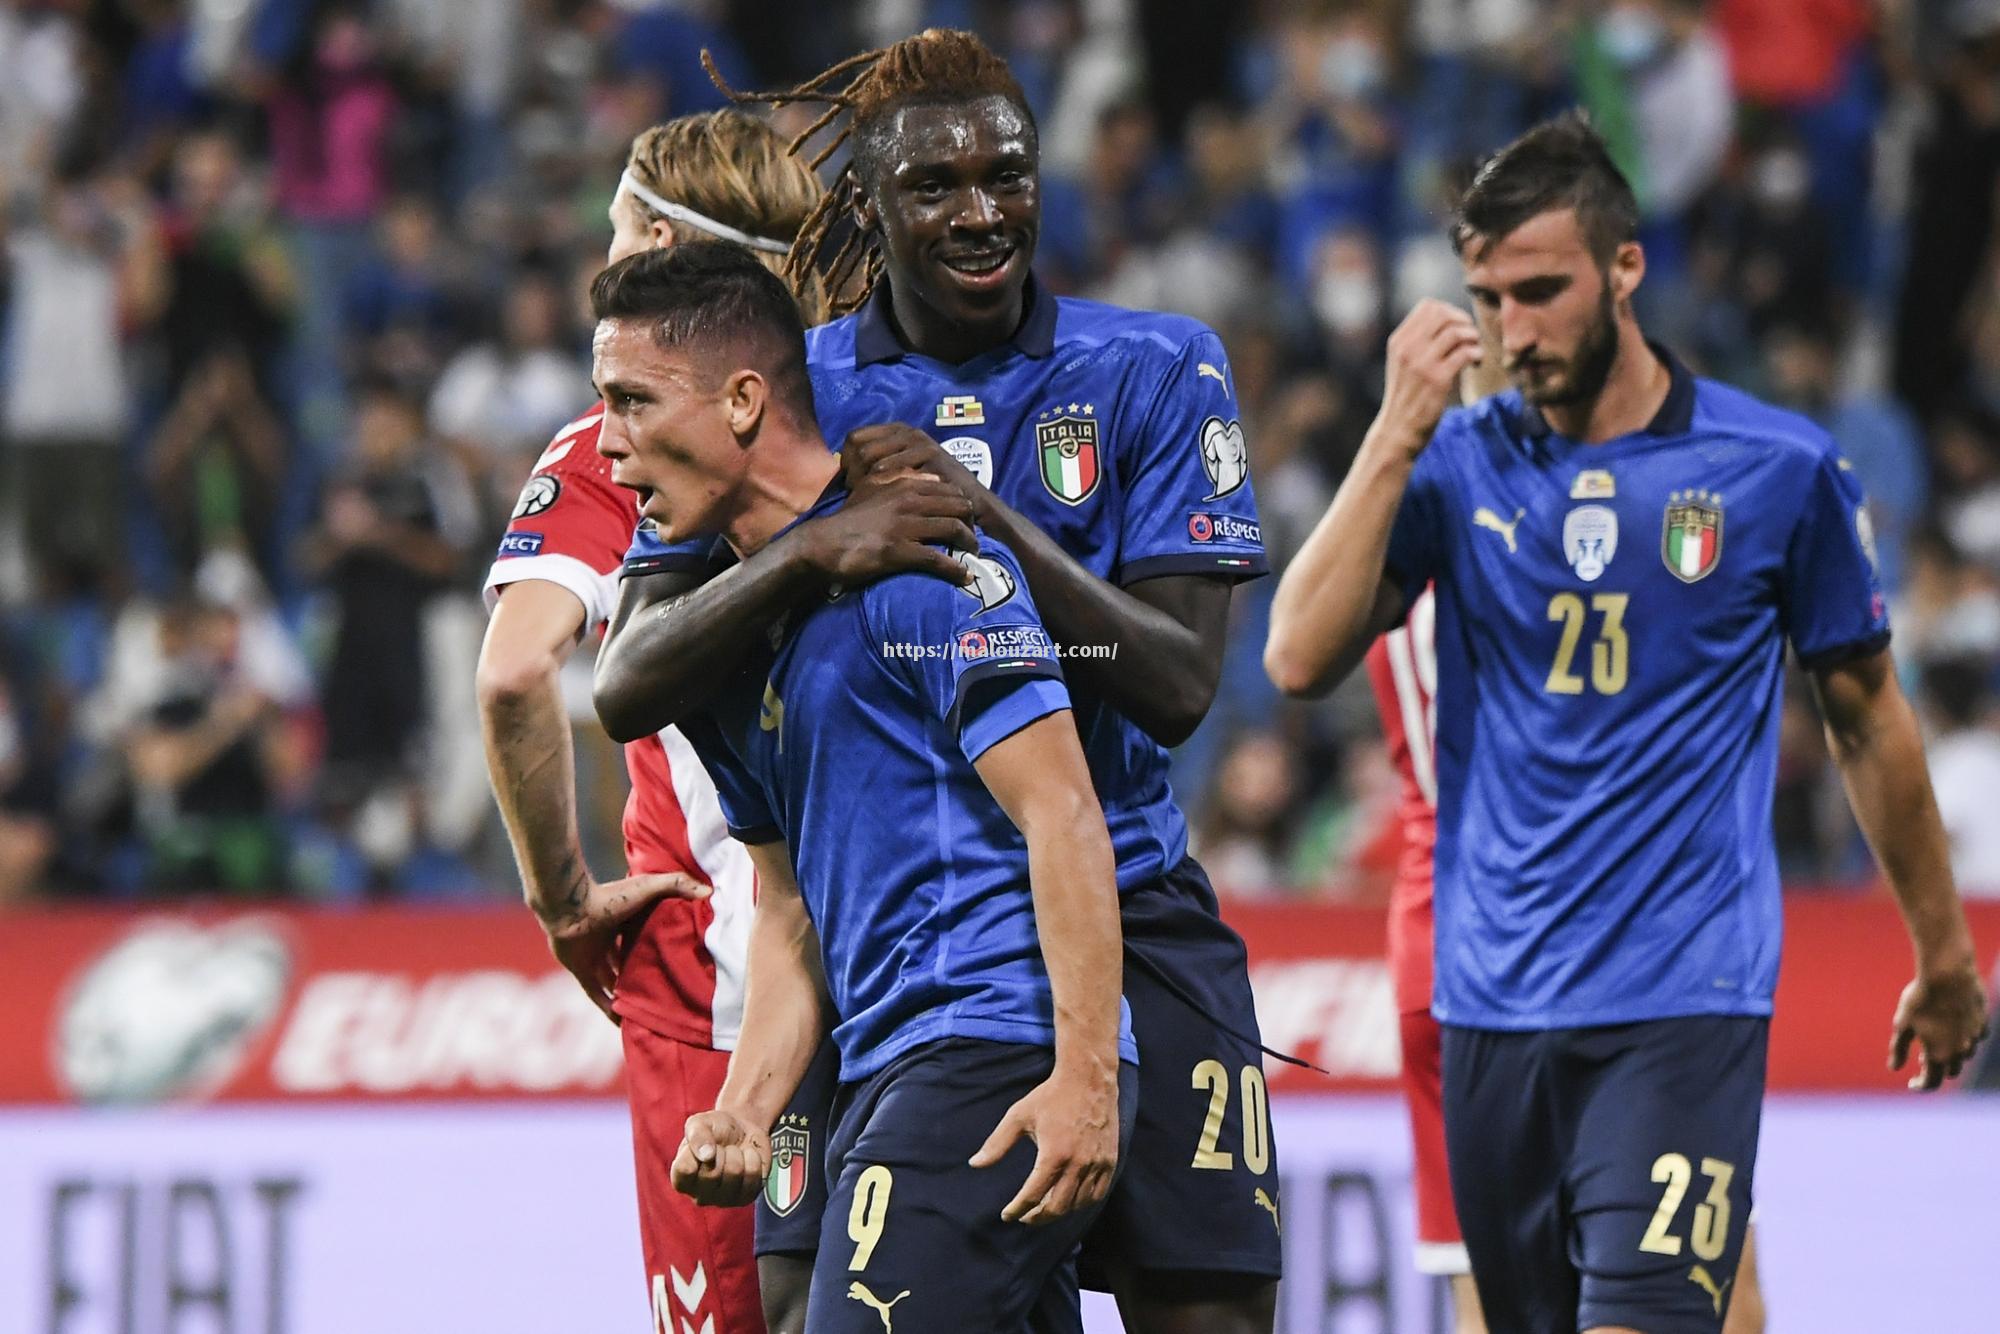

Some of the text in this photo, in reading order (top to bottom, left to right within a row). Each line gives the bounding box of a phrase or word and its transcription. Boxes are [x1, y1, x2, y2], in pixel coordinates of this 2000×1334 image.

[1042, 424, 1092, 441] ITALIA
[1213, 520, 1261, 542] RESPECT
[986, 630, 1046, 646] RESPECT
[1545, 592, 1629, 694] 23
[270, 972, 626, 1092] EURO
[1191, 1059, 1269, 1176] 20
[47, 1173, 312, 1334] FIAT
[847, 1165, 893, 1272] 9
[1638, 1152, 1736, 1262] 23
